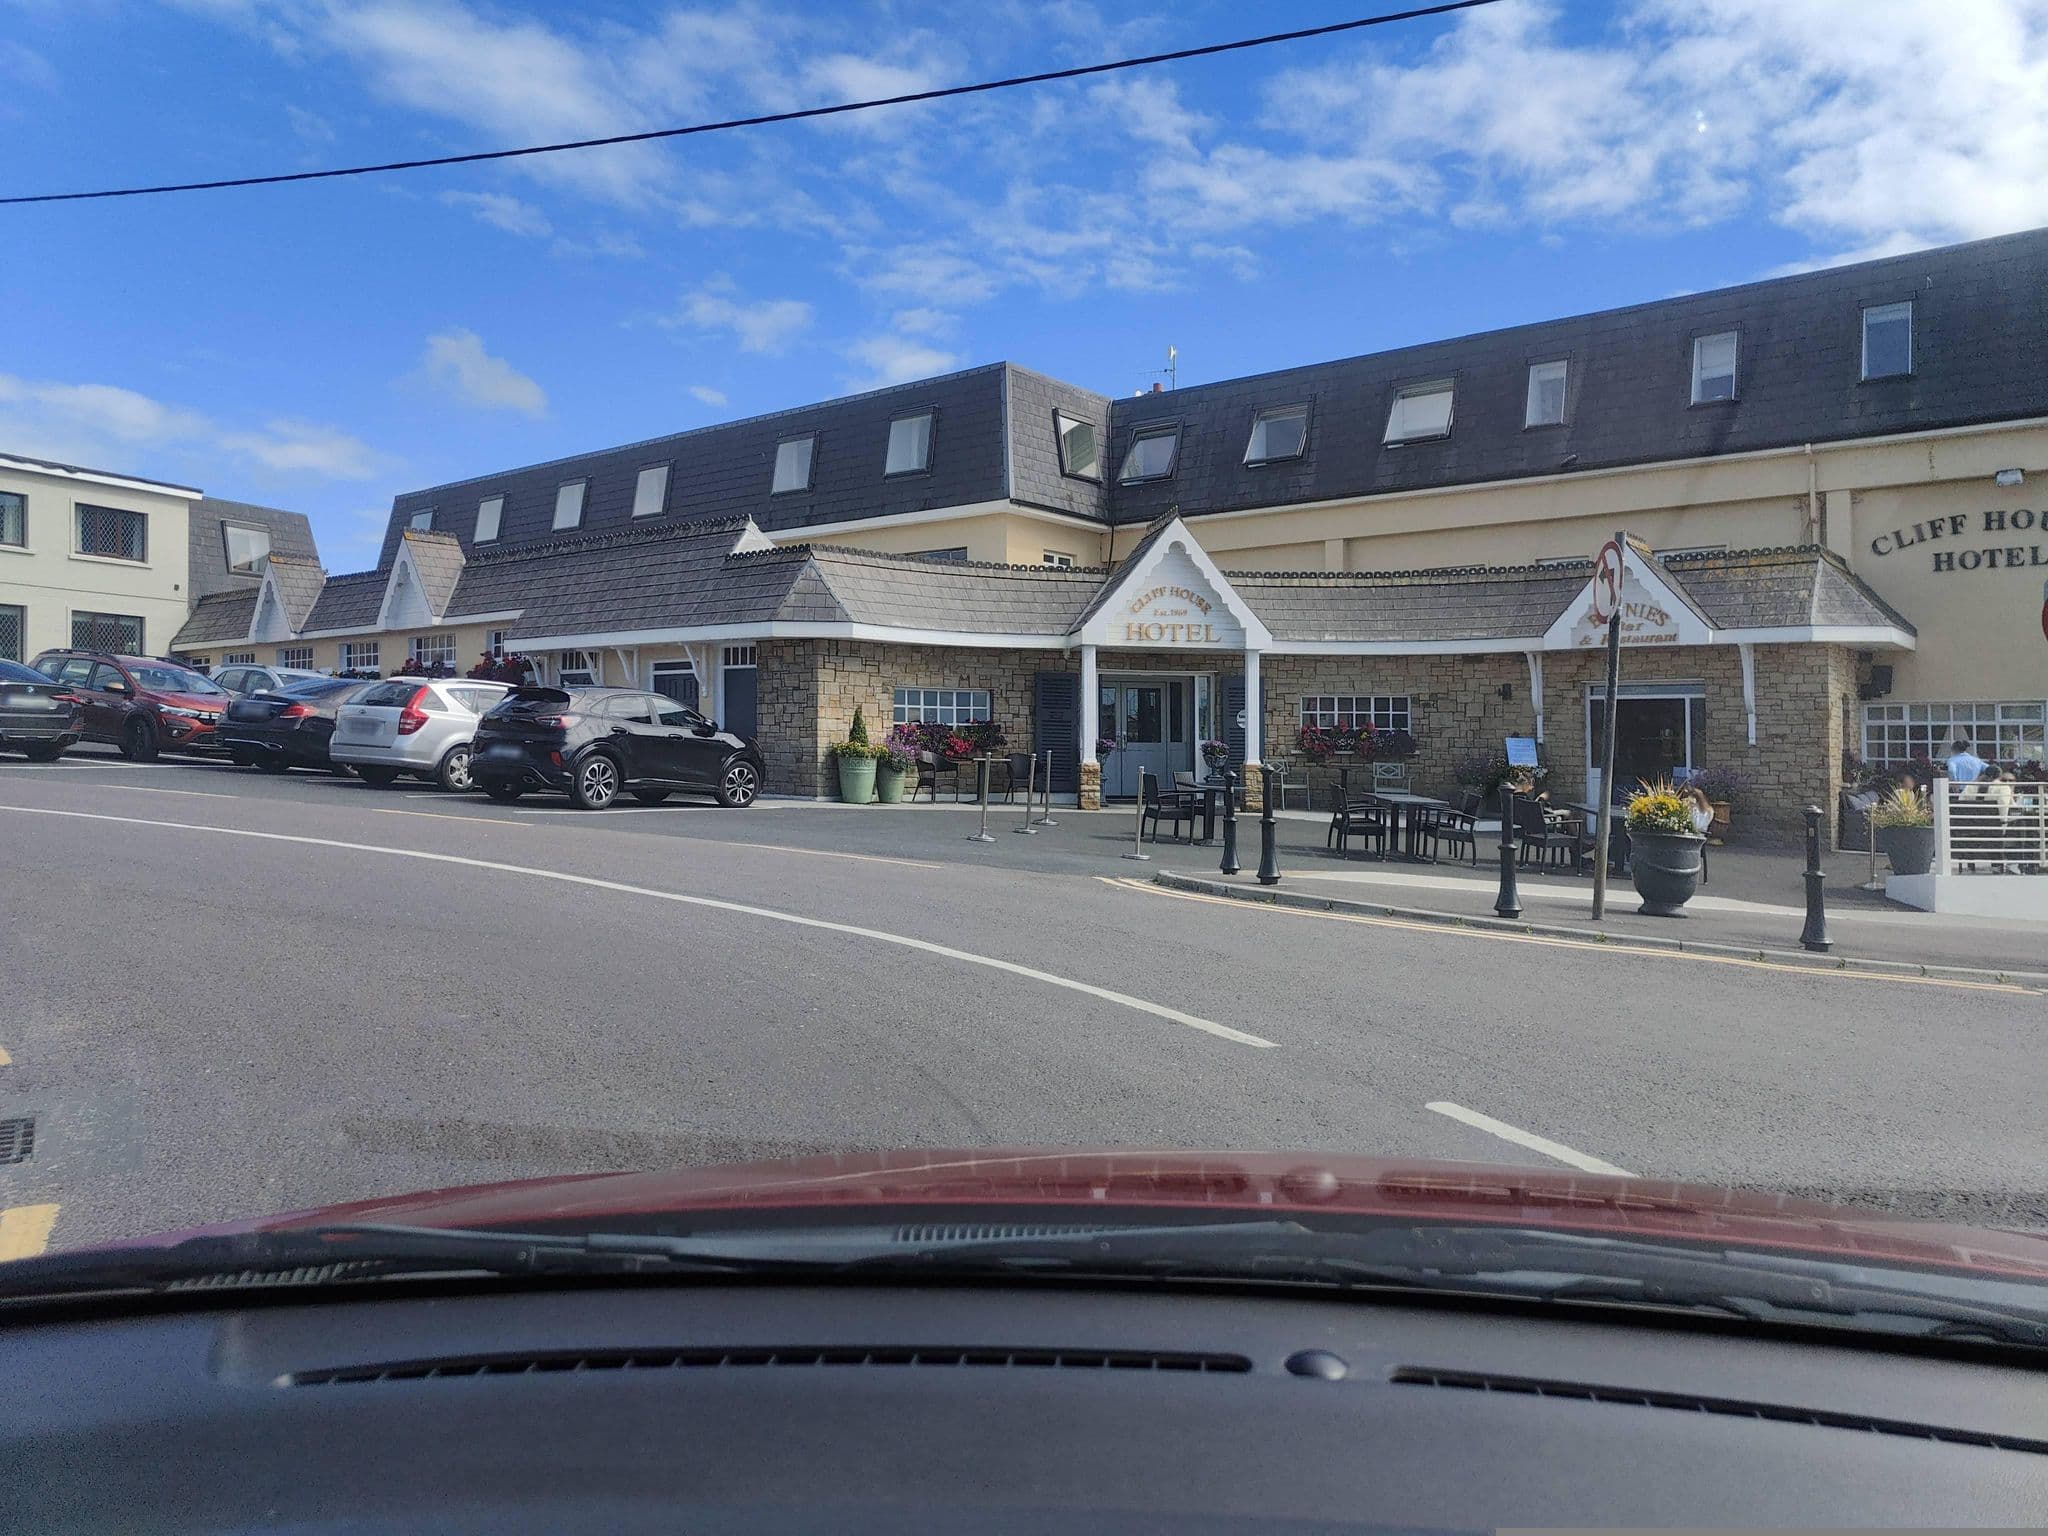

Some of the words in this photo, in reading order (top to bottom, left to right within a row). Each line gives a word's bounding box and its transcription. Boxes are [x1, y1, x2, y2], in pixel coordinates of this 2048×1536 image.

[1871, 514, 1967, 556] CLIFF
[1932, 545, 2048, 573] HOTEL
[1131, 587, 1167, 614] CLIFF
[1169, 586, 1212, 616] HOUSE
[1126, 622, 1222, 642] HOTEL
[1600, 633, 1677, 646] Rstaurant
